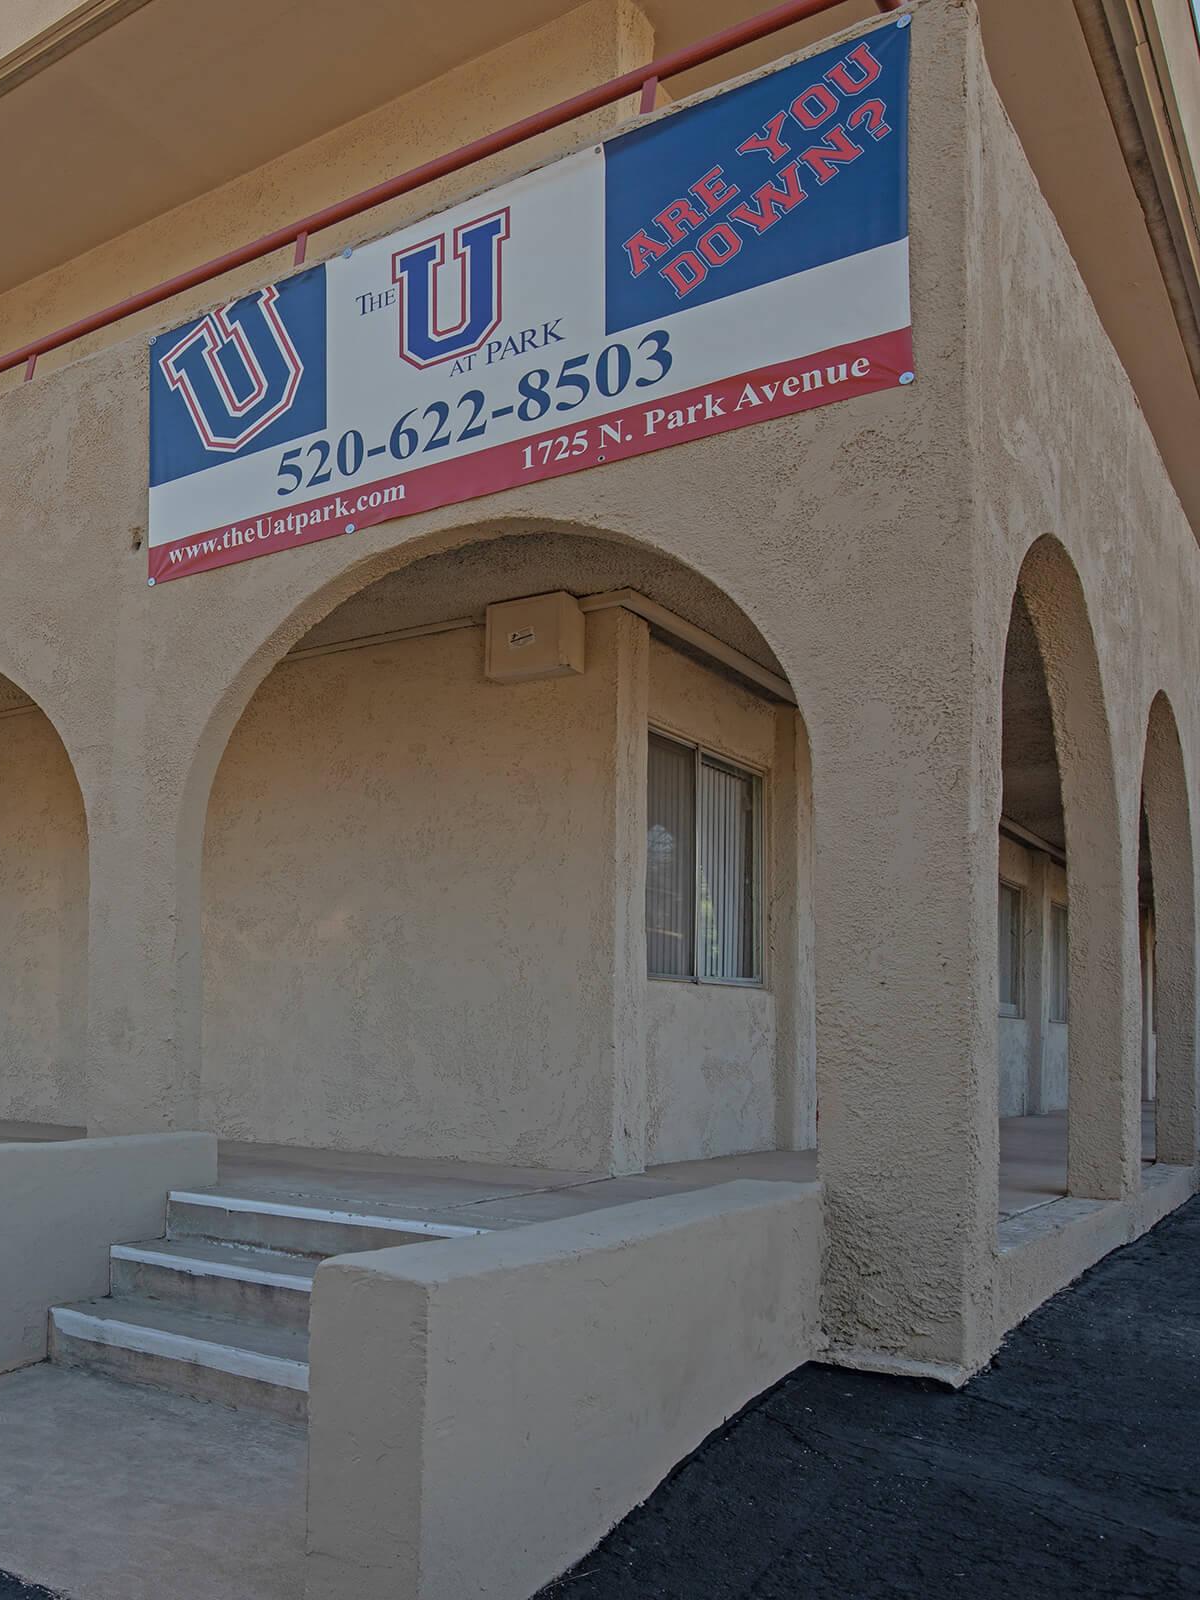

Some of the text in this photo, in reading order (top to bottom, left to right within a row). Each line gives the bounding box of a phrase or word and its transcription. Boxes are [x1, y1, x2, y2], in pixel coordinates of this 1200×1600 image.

[622, 42, 883, 278] ARE YOU
[658, 98, 893, 300] DOWN?
[158, 284, 305, 454] U
[355, 206, 511, 371] THE U
[449, 317, 567, 377] AT PARK
[277, 329, 674, 497] 520-622-8503
[521, 356, 871, 470] 1725 N. Park Avenue
[168, 481, 407, 565] www.theUatpark.com
